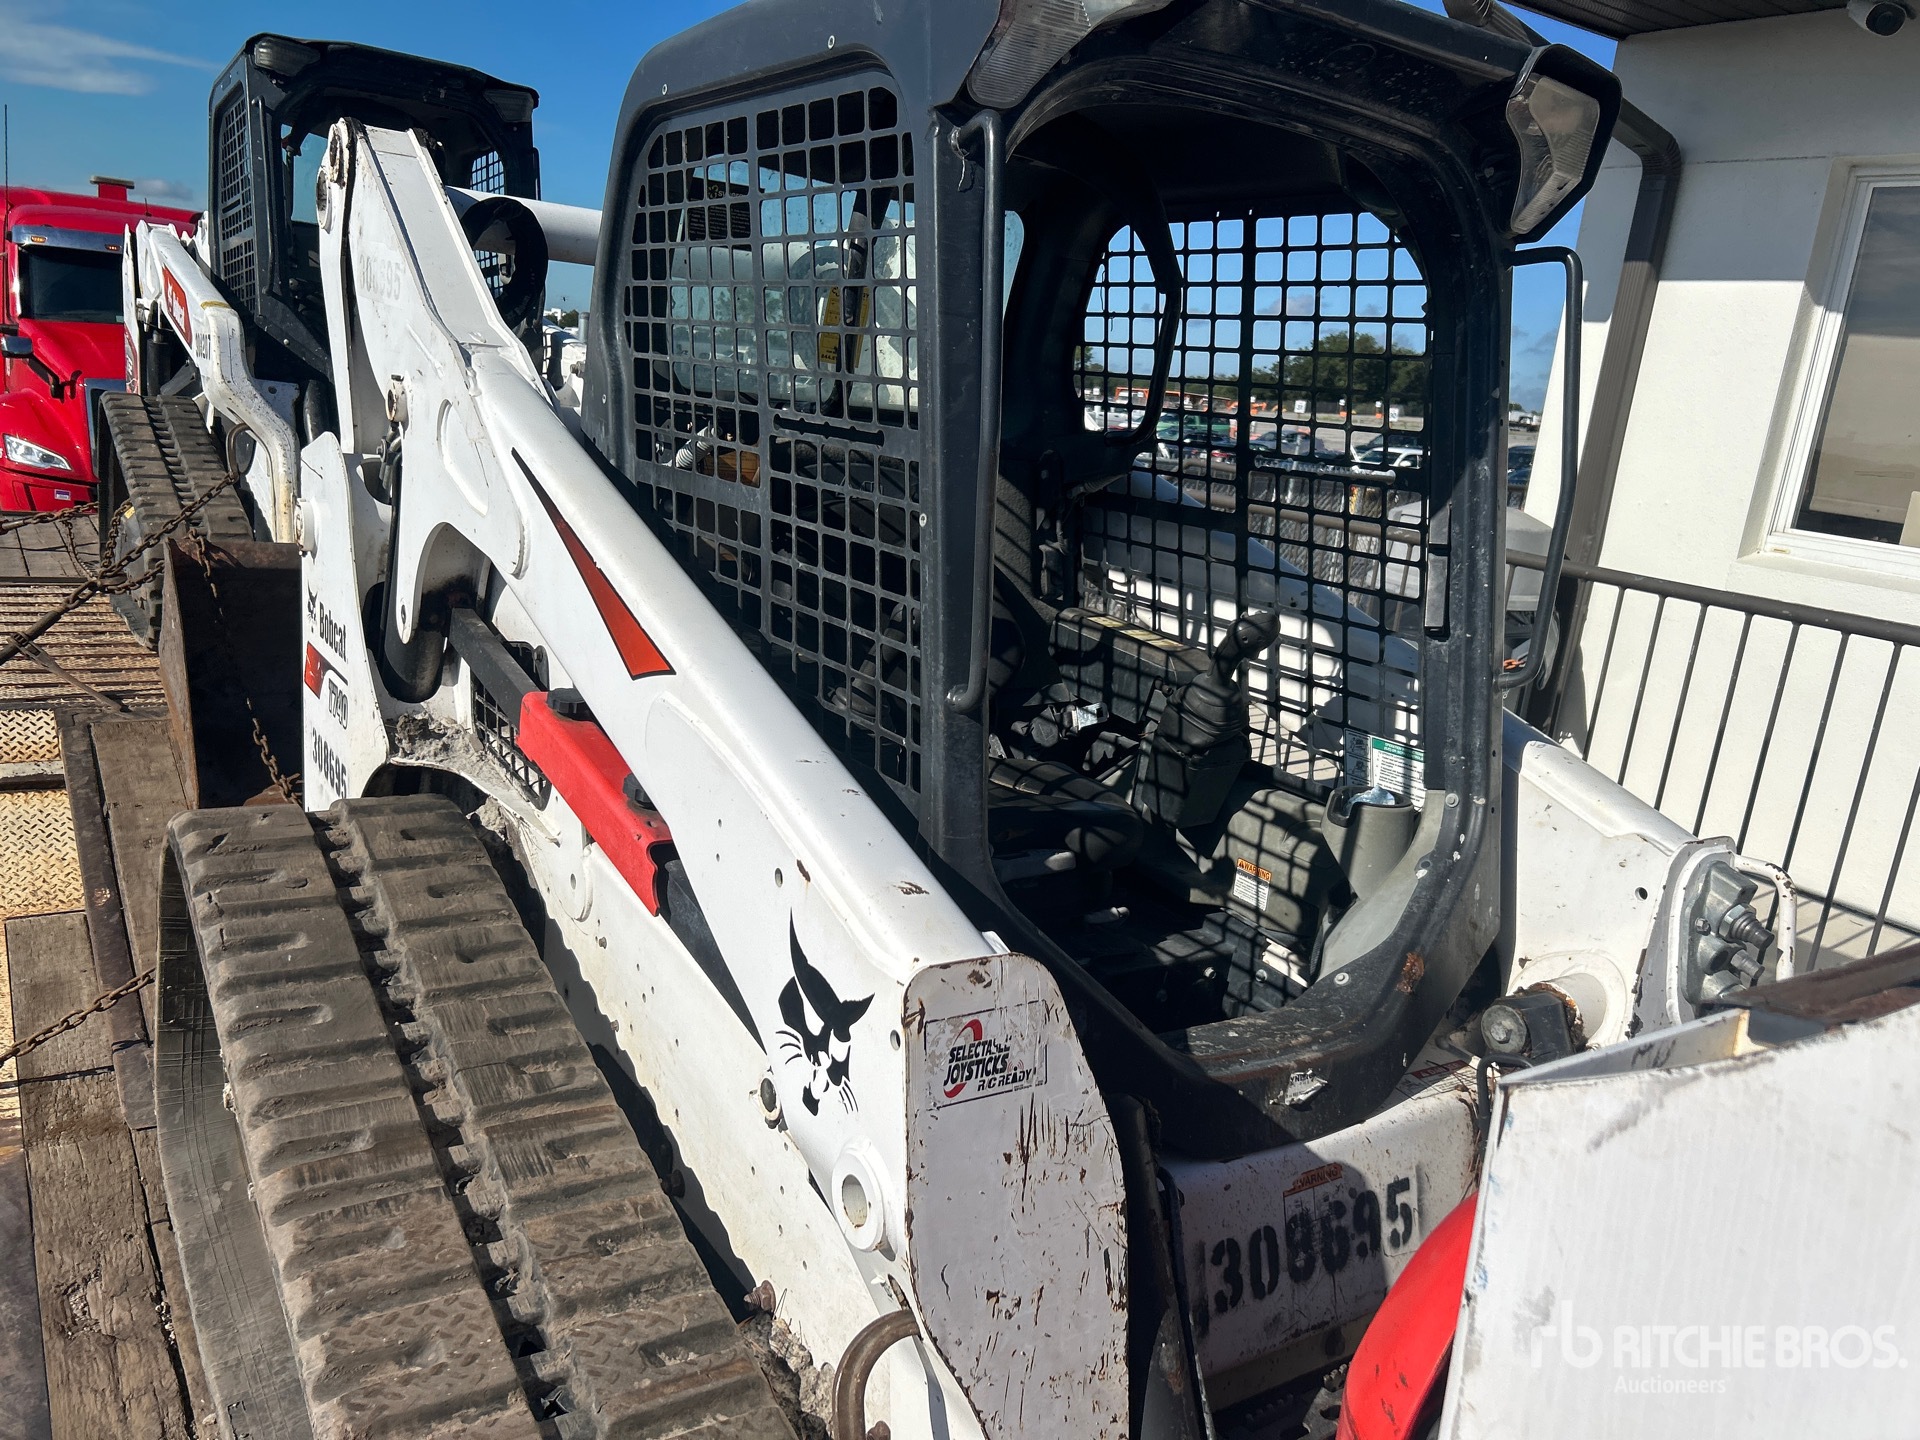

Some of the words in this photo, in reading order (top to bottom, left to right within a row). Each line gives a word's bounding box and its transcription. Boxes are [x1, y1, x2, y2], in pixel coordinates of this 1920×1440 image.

[360, 254, 401, 301] 3095
[319, 601, 347, 660] Bobcat
[328, 680, 349, 730] T740
[312, 728, 347, 798] 308695
[943, 1052, 1010, 1087] JOYSTICKS
[998, 1068, 1032, 1087] READY
[1210, 1176, 1413, 1313] 308695
